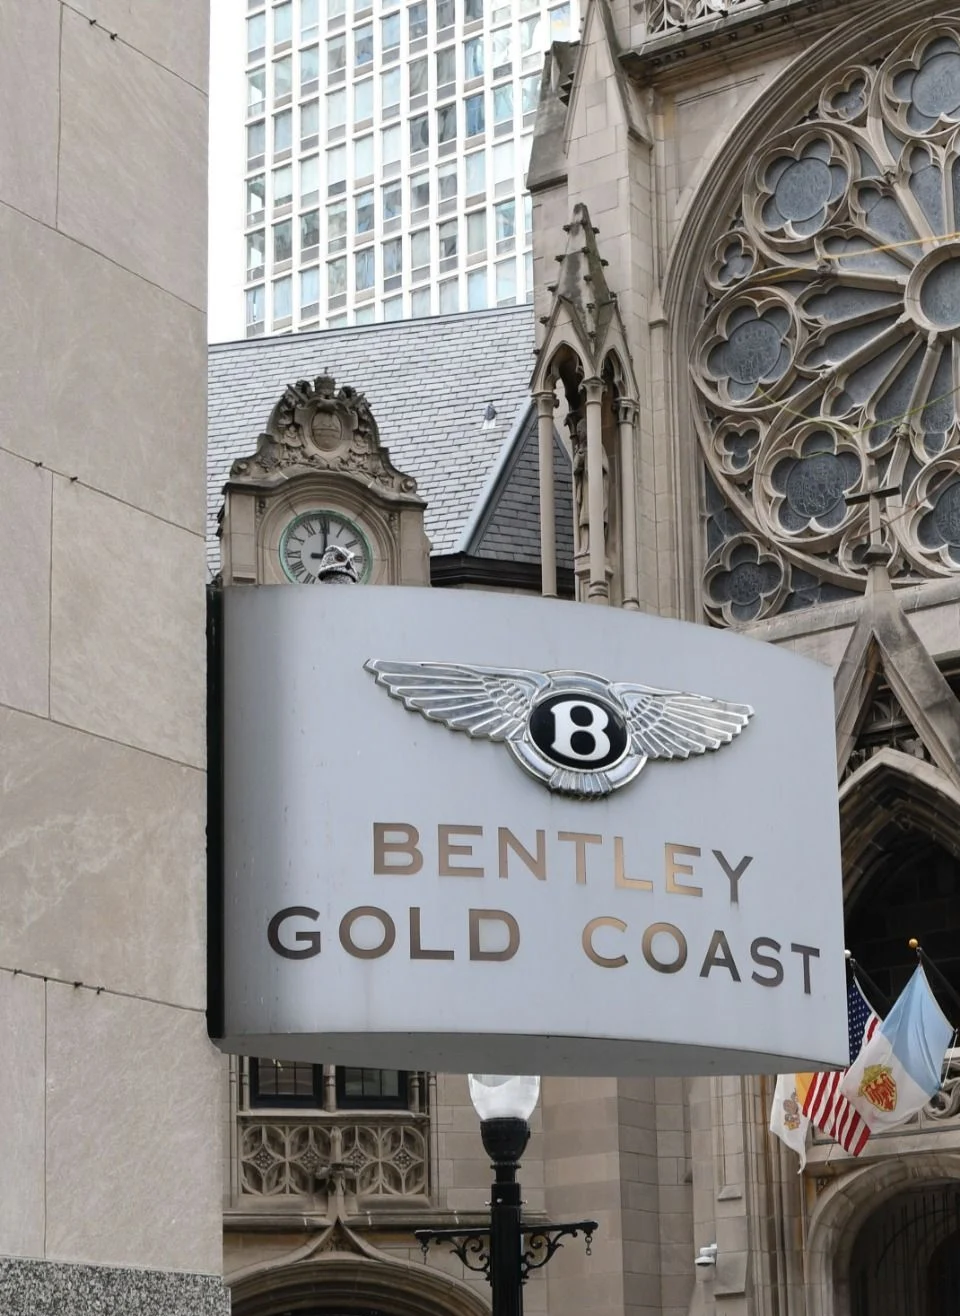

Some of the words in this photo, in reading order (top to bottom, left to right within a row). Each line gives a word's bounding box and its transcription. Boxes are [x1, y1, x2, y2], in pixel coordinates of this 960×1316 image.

[551, 699, 611, 762] B
[373, 822, 754, 903] BENTLEY
[267, 905, 521, 961] GOLD
[581, 915, 821, 995] COAST
